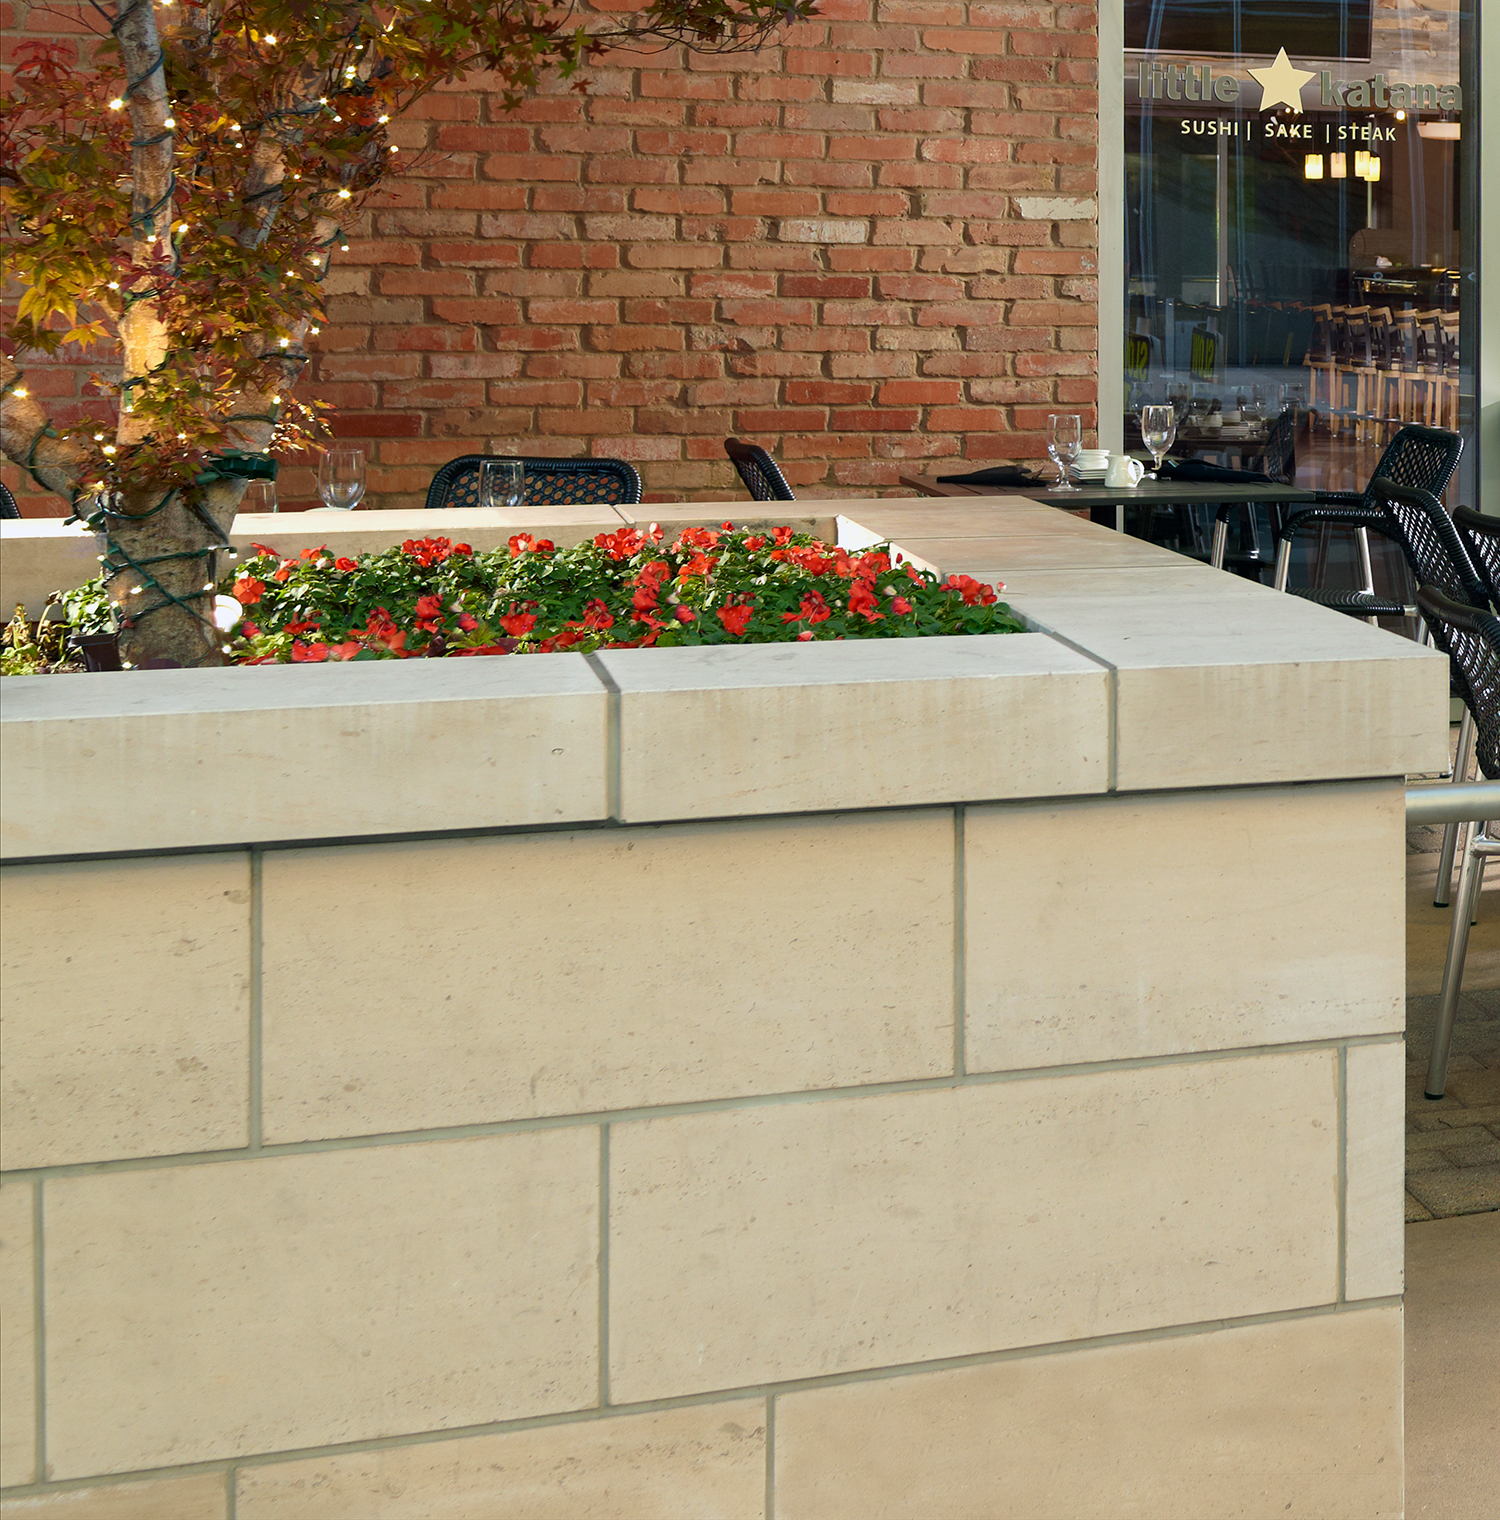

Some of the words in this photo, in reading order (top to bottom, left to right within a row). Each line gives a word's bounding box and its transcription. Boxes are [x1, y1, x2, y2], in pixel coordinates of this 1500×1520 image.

[1138, 62, 1240, 103] little
[1320, 71, 1464, 111] katana
[1180, 120, 1239, 136] SUSHI
[1265, 123, 1313, 139] SAKE
[1338, 125, 1397, 142] STEAK
